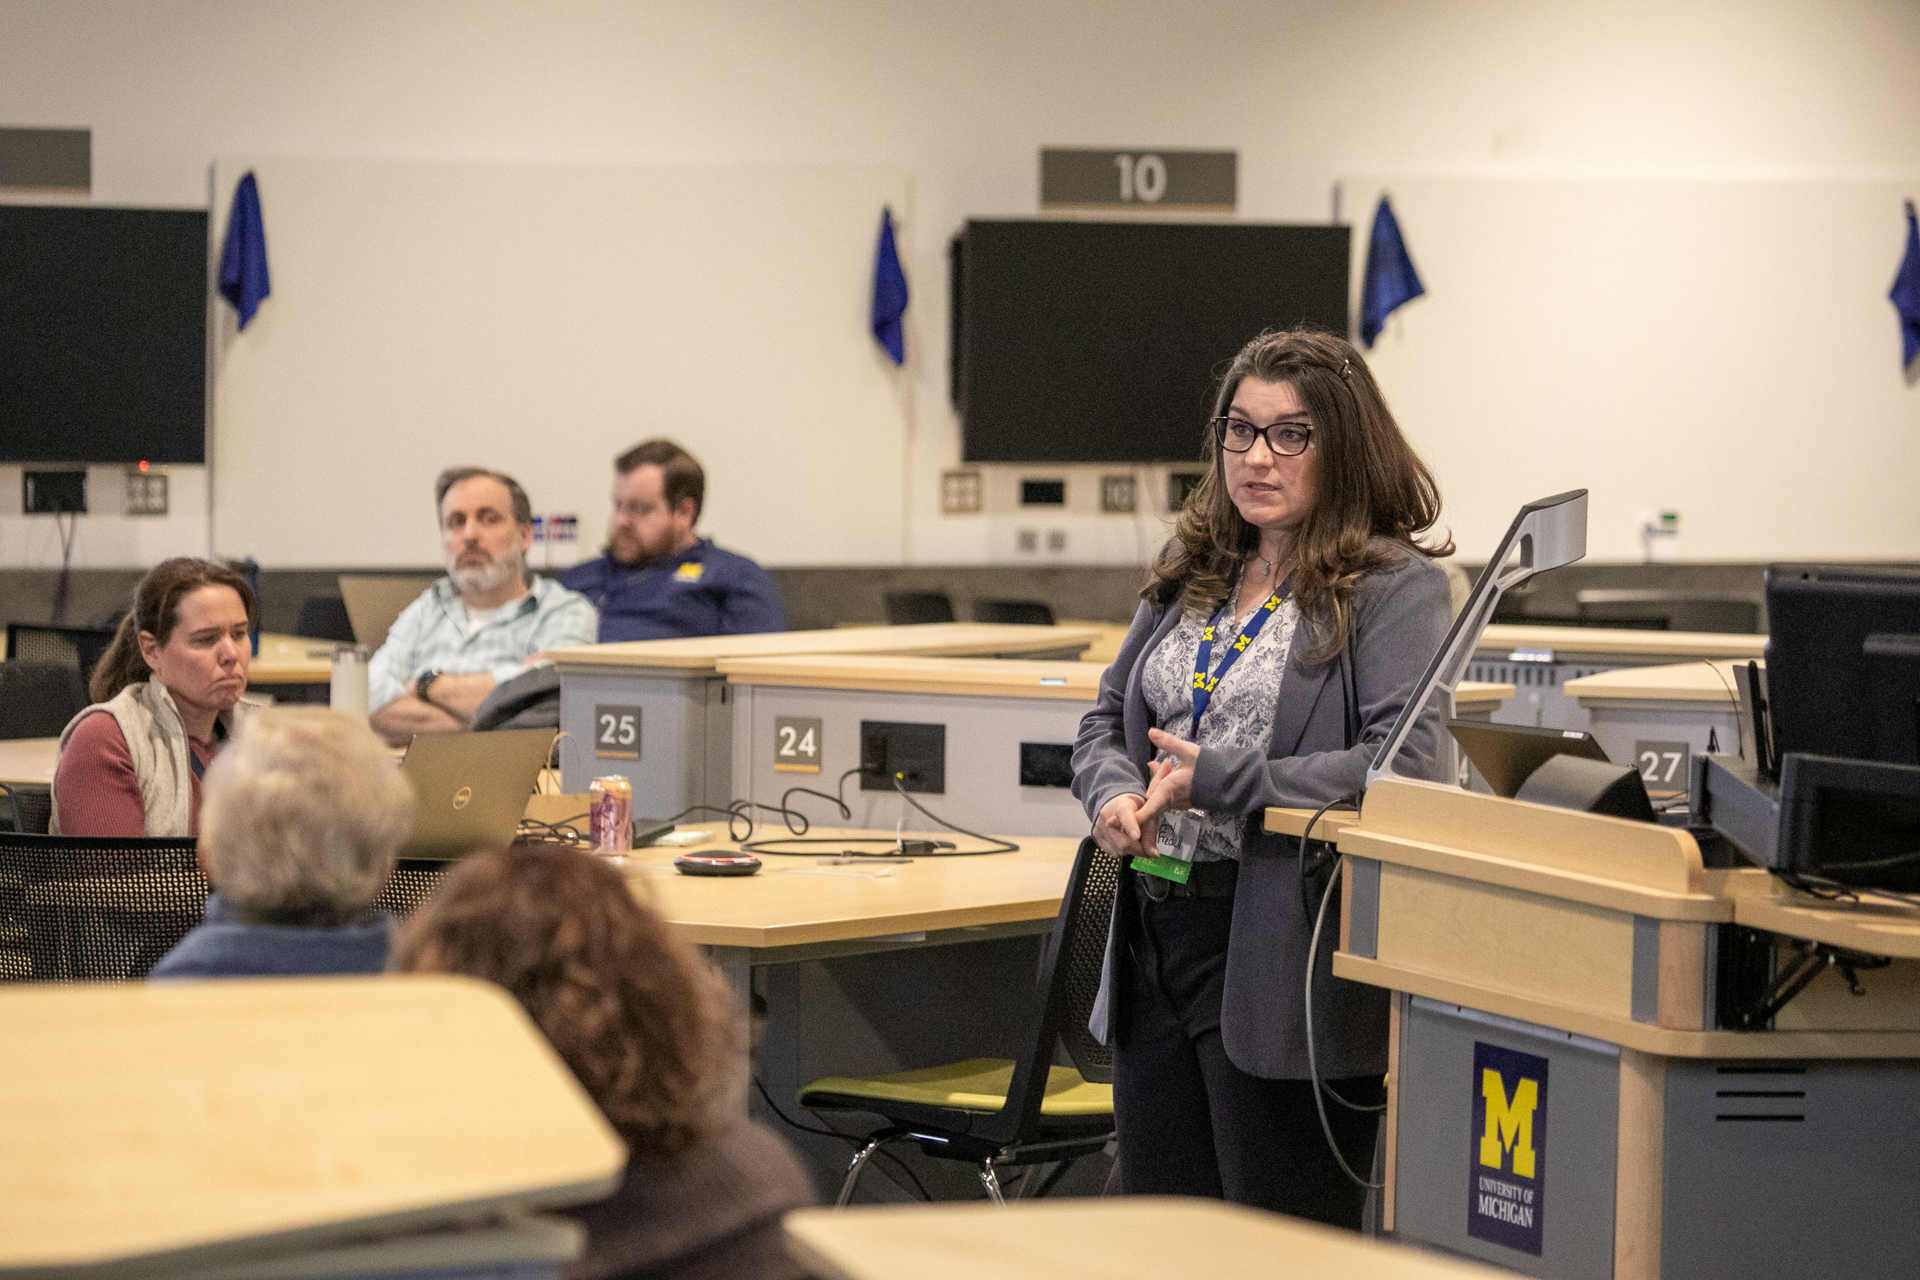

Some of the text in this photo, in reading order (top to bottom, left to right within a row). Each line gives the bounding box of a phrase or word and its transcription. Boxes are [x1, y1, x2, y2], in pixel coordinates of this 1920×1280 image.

[1114, 154, 1168, 202] 10
[1264, 595, 1281, 611] M
[1202, 625, 1216, 641] M
[1233, 634, 1252, 652] M
[1193, 672, 1205, 689] M
[600, 714, 636, 745] 25
[779, 726, 817, 757] 24
[1639, 751, 1683, 783] 27
[1480, 1068, 1538, 1179] M
[1479, 1176, 1534, 1205] UNIVERSITY OF
[1478, 1194, 1533, 1228] MICHIGAN
